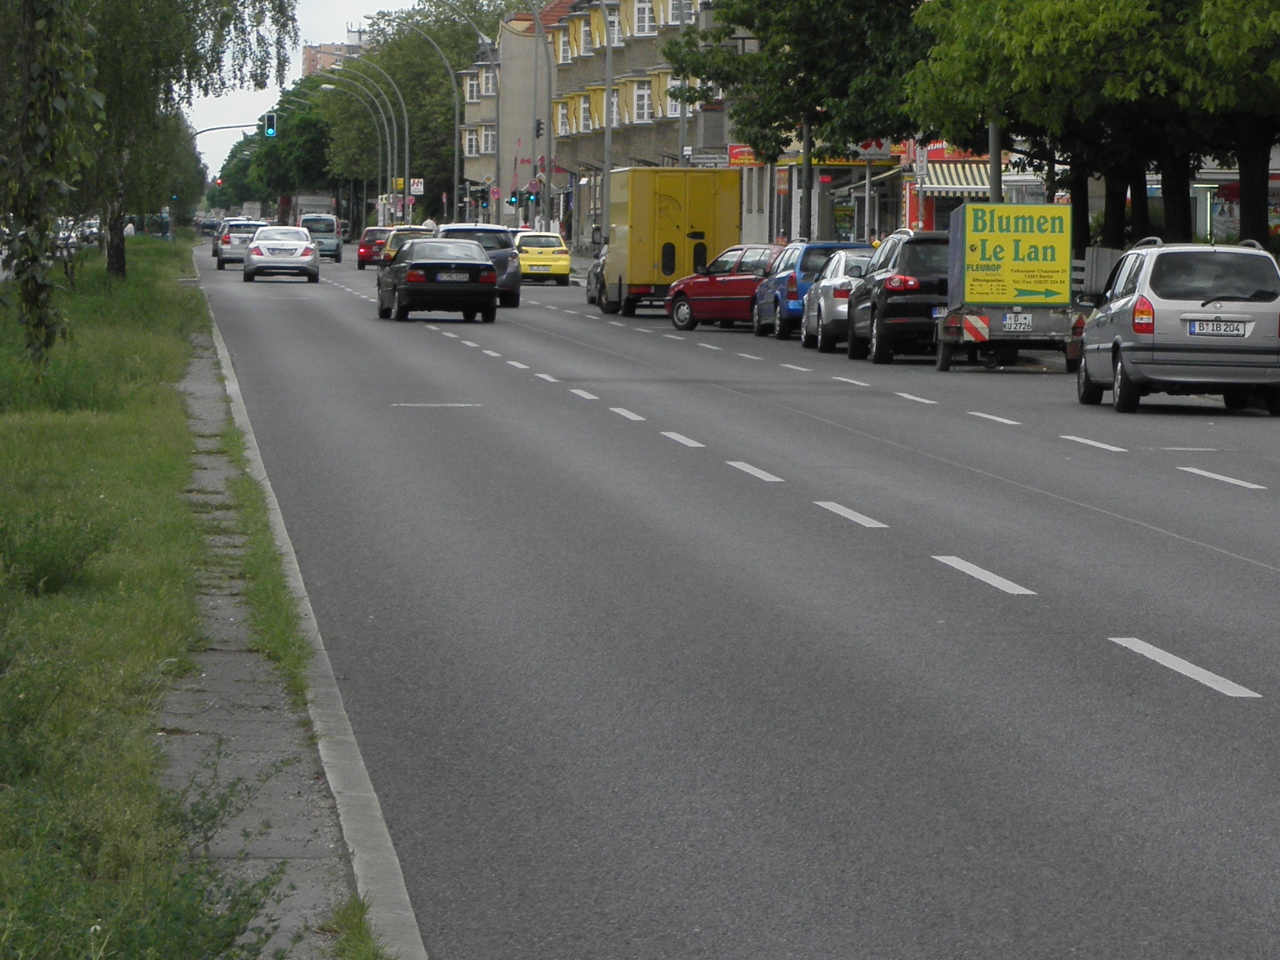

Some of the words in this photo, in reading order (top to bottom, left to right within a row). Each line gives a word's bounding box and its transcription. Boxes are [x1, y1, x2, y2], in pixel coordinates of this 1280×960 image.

[972, 208, 1064, 234] Blumen
[979, 238, 1005, 263] Le
[1012, 238, 1057, 263] Lan
[966, 263, 1002, 273] FLEUROP
[1013, 314, 1020, 322] B
[1013, 322, 1032, 330] 2726
[1198, 322, 1205, 332] B
[1211, 322, 1222, 332] IB
[1223, 323, 1240, 333] 204
